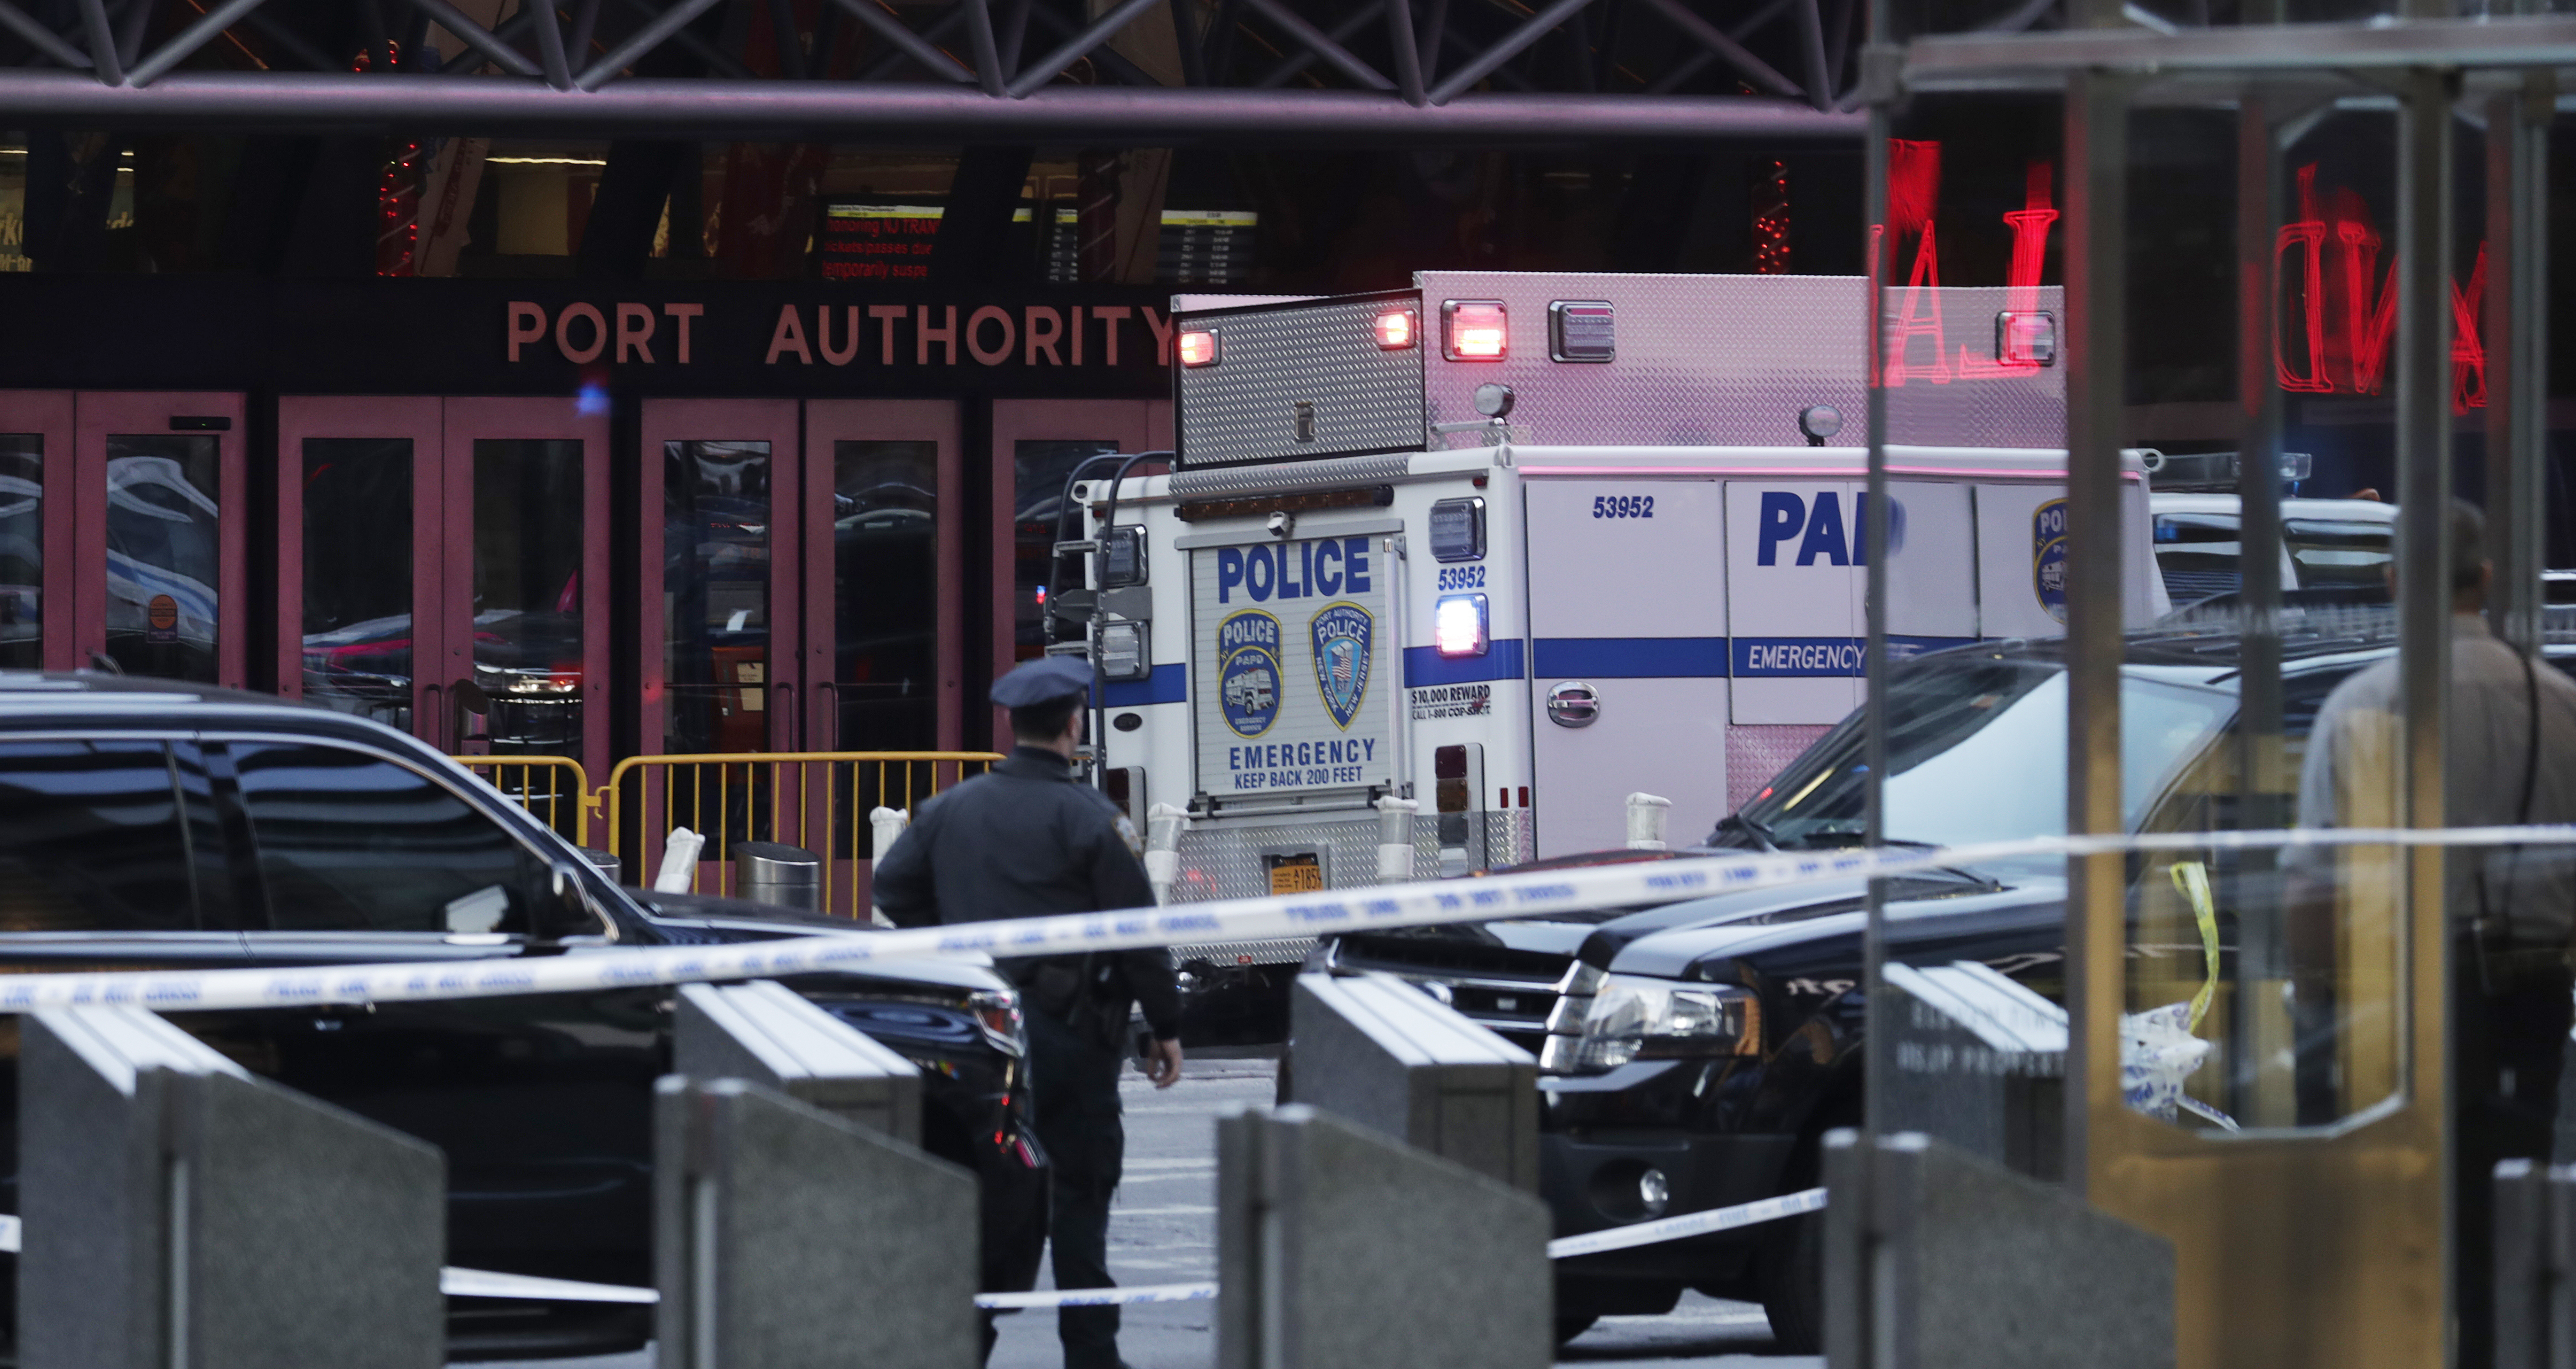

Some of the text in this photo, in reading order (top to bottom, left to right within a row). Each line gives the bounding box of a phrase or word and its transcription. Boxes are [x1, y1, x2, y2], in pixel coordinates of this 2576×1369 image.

[508, 301, 1177, 366] PORT AUTHORITY
[1592, 496, 1654, 518] 53952
[1218, 538, 1371, 603] POLICE
[1438, 565, 1486, 591] 53952
[1223, 619, 1275, 647] POLICE
[1317, 619, 1367, 645] POLICE
[1235, 655, 1264, 666] PAPD
[1748, 645, 1867, 669] EMERGENCY
[1450, 684, 1490, 701] REWARD
[1229, 738, 1375, 770] EMERGENCY
[1234, 766, 1363, 789] KEEP BACK 200 FEET
